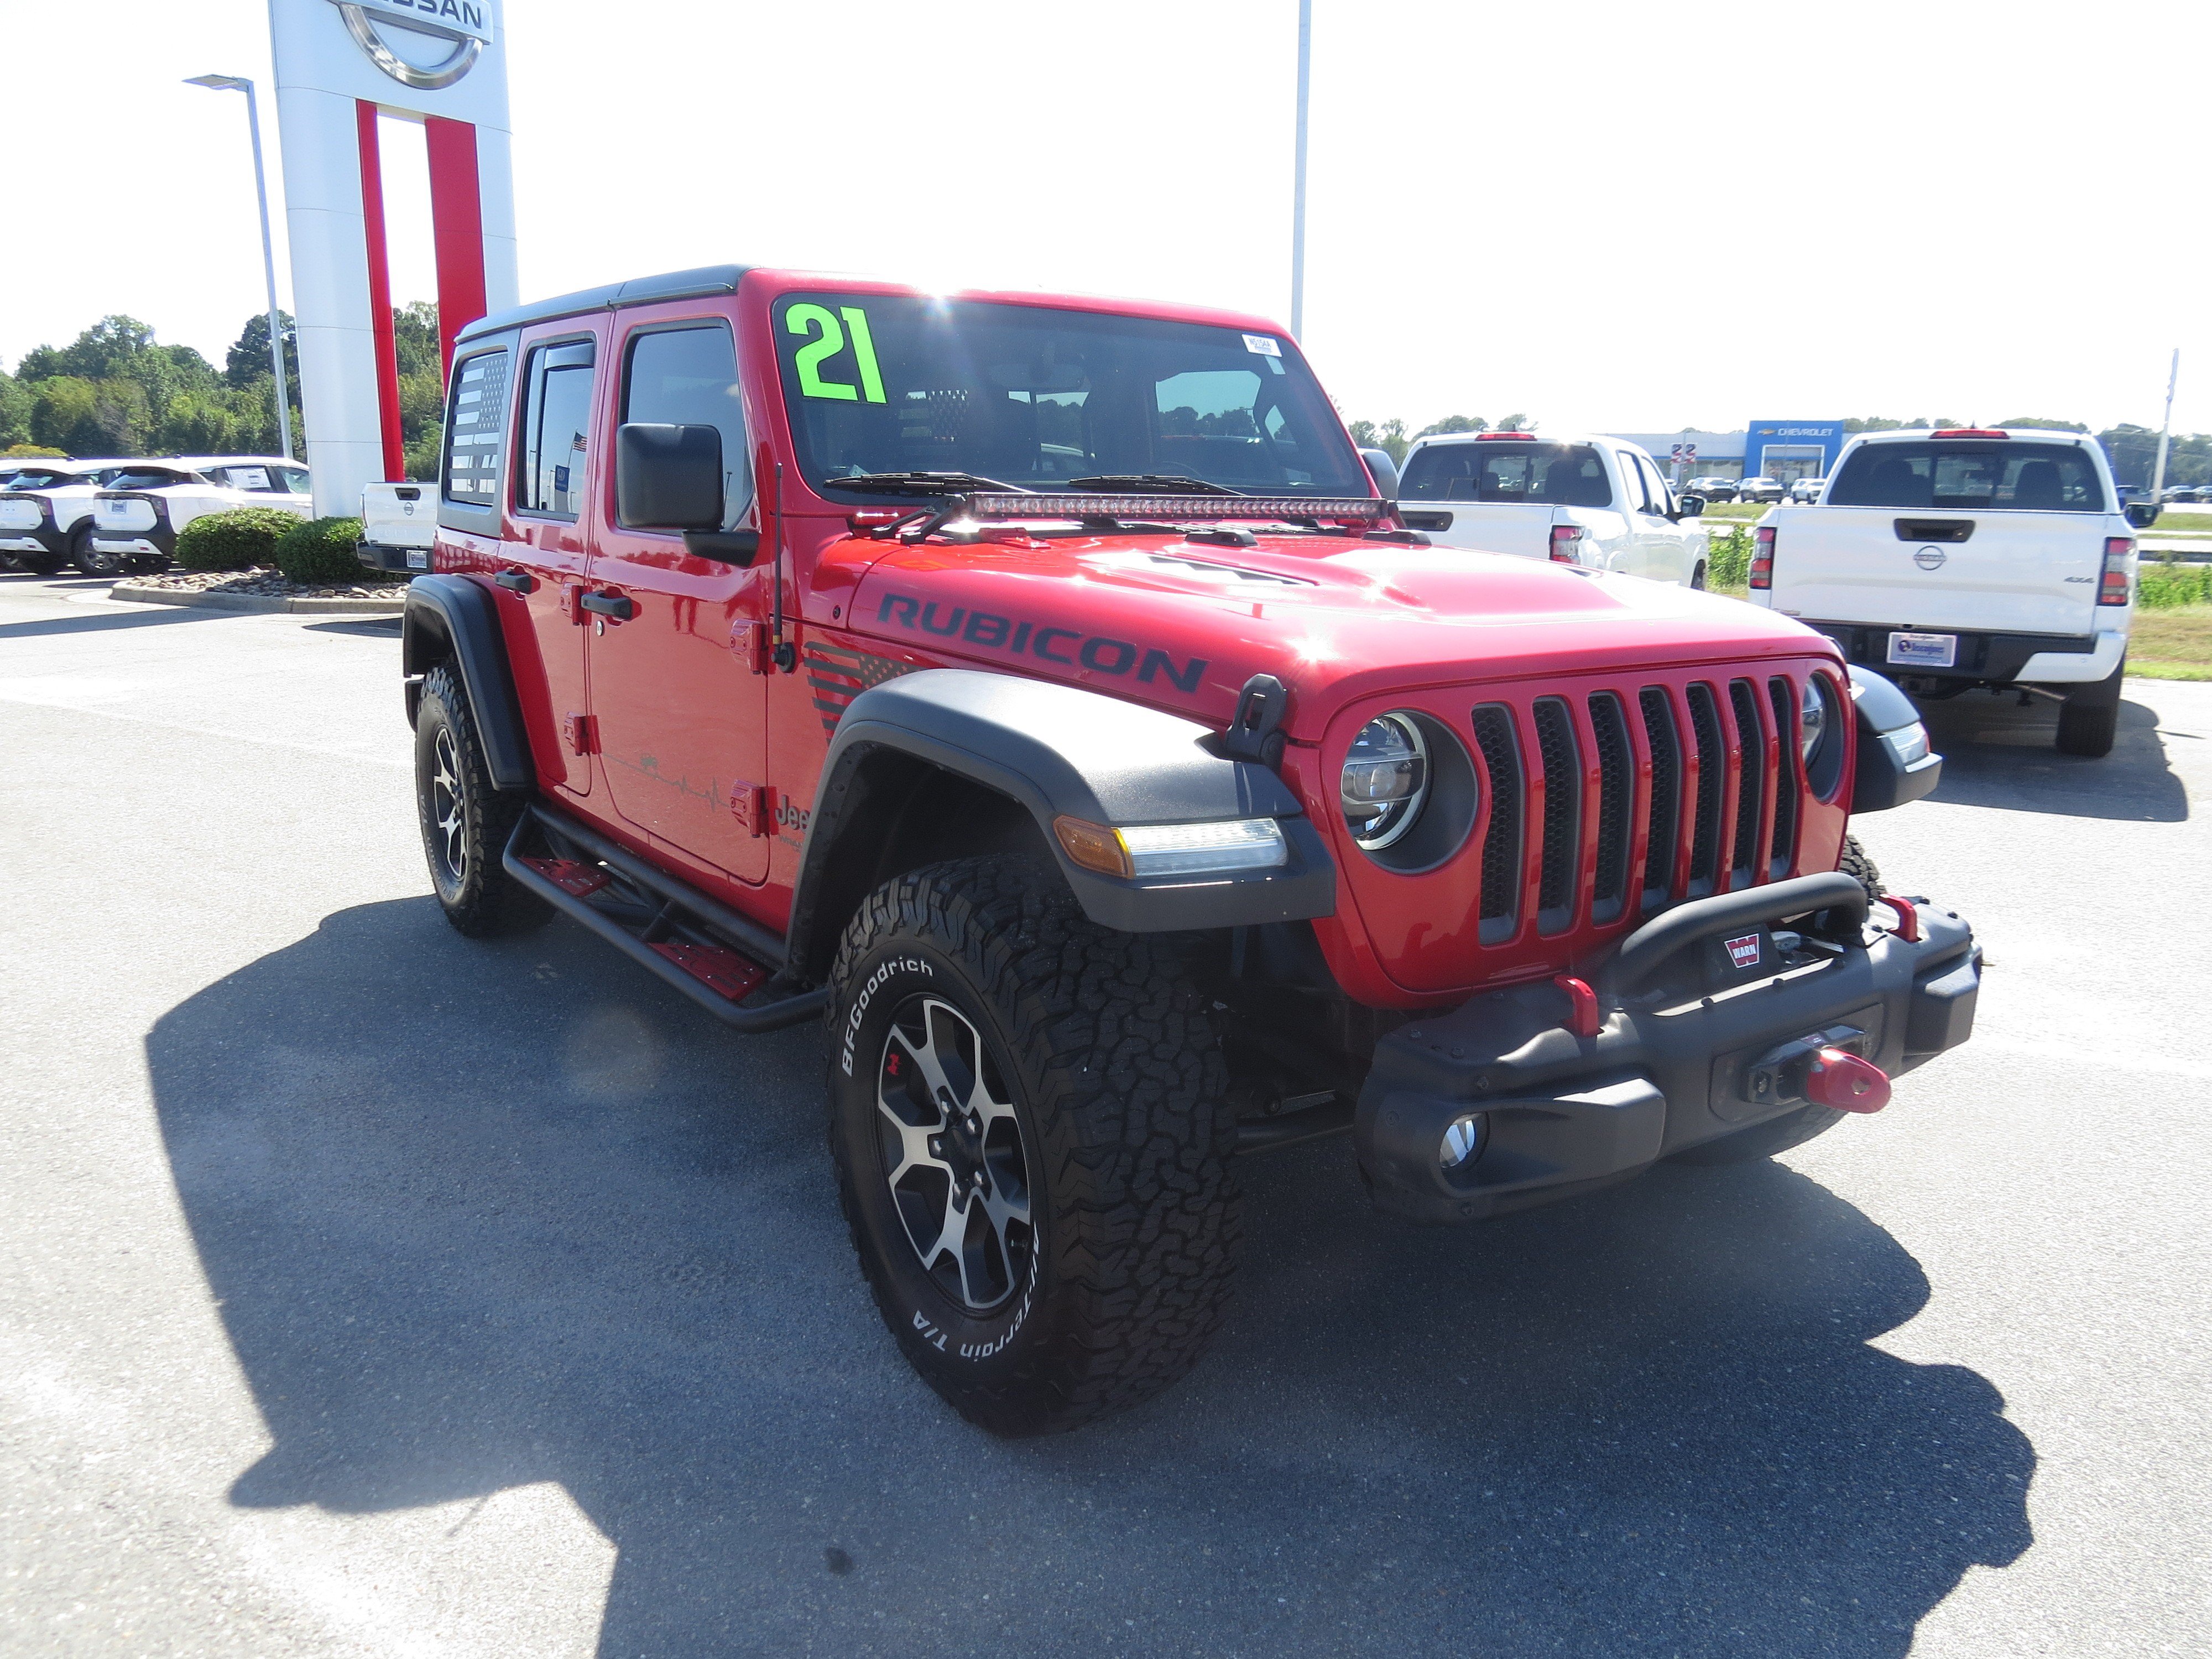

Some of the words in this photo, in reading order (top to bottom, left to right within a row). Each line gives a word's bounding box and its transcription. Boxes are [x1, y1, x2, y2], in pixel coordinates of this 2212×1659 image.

[393, 0, 482, 29] SAN
[785, 302, 887, 404] 21
[877, 593, 1211, 693] RUBICON
[775, 794, 811, 833] Jee
[1732, 944, 1756, 959] WARN
[842, 956, 933, 1077] BFGoodrich
[960, 1221, 1040, 1362] All-Terrain
[912, 1310, 948, 1352] T/A
